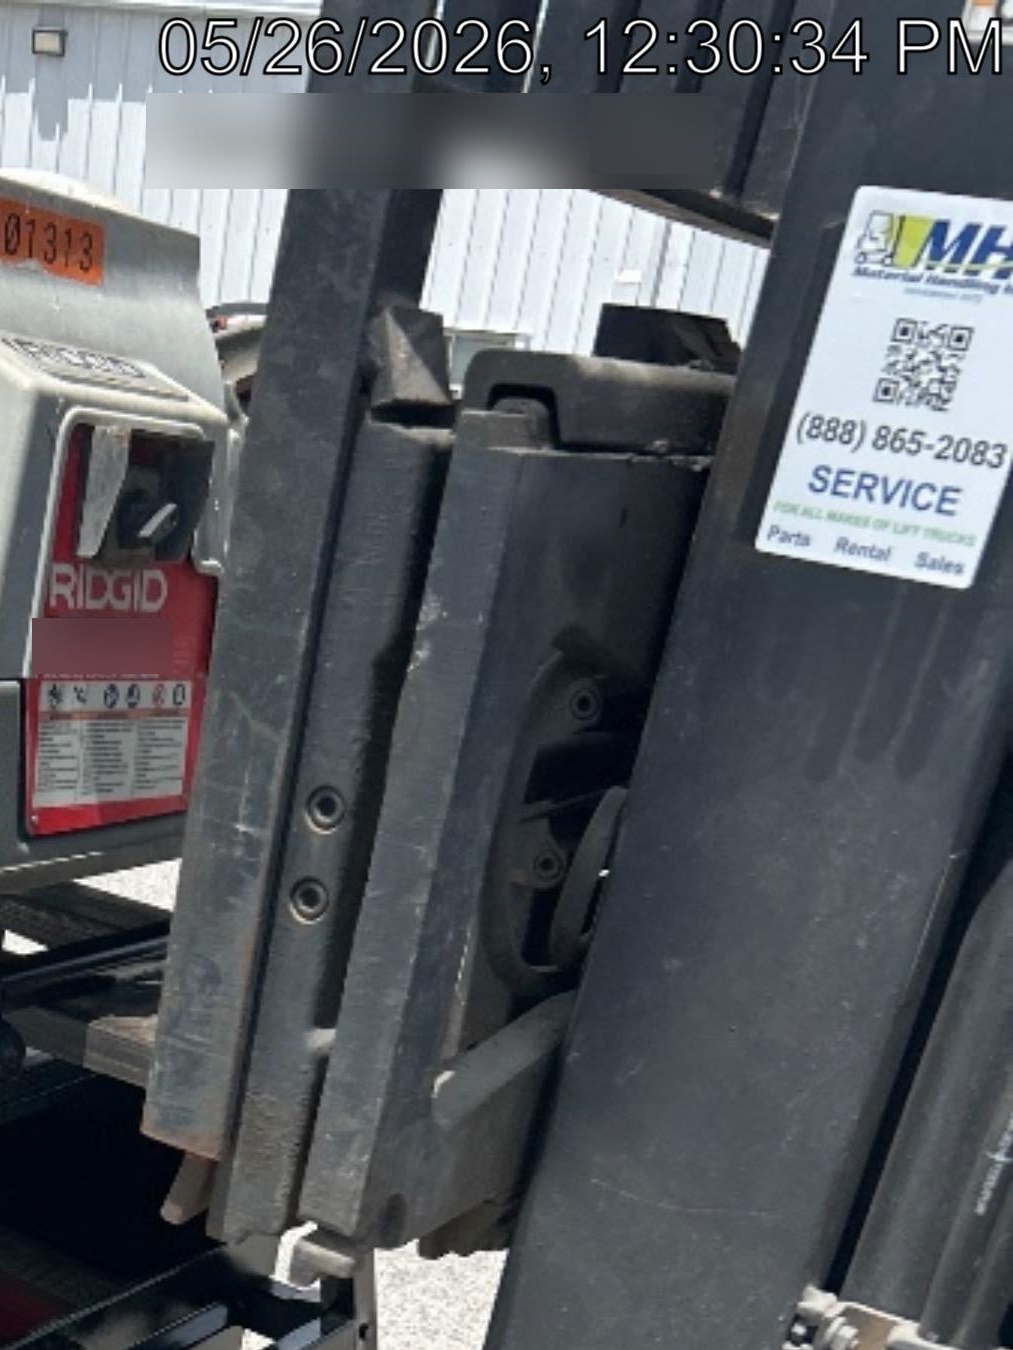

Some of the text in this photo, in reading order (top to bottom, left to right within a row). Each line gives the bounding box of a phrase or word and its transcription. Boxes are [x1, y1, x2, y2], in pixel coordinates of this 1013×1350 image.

[796, 412, 1008, 470] (888) 865-2083
[807, 463, 963, 517] SERVICE
[766, 523, 965, 575] Parts Rental Sales
[49, 562, 169, 613] RIDGID
